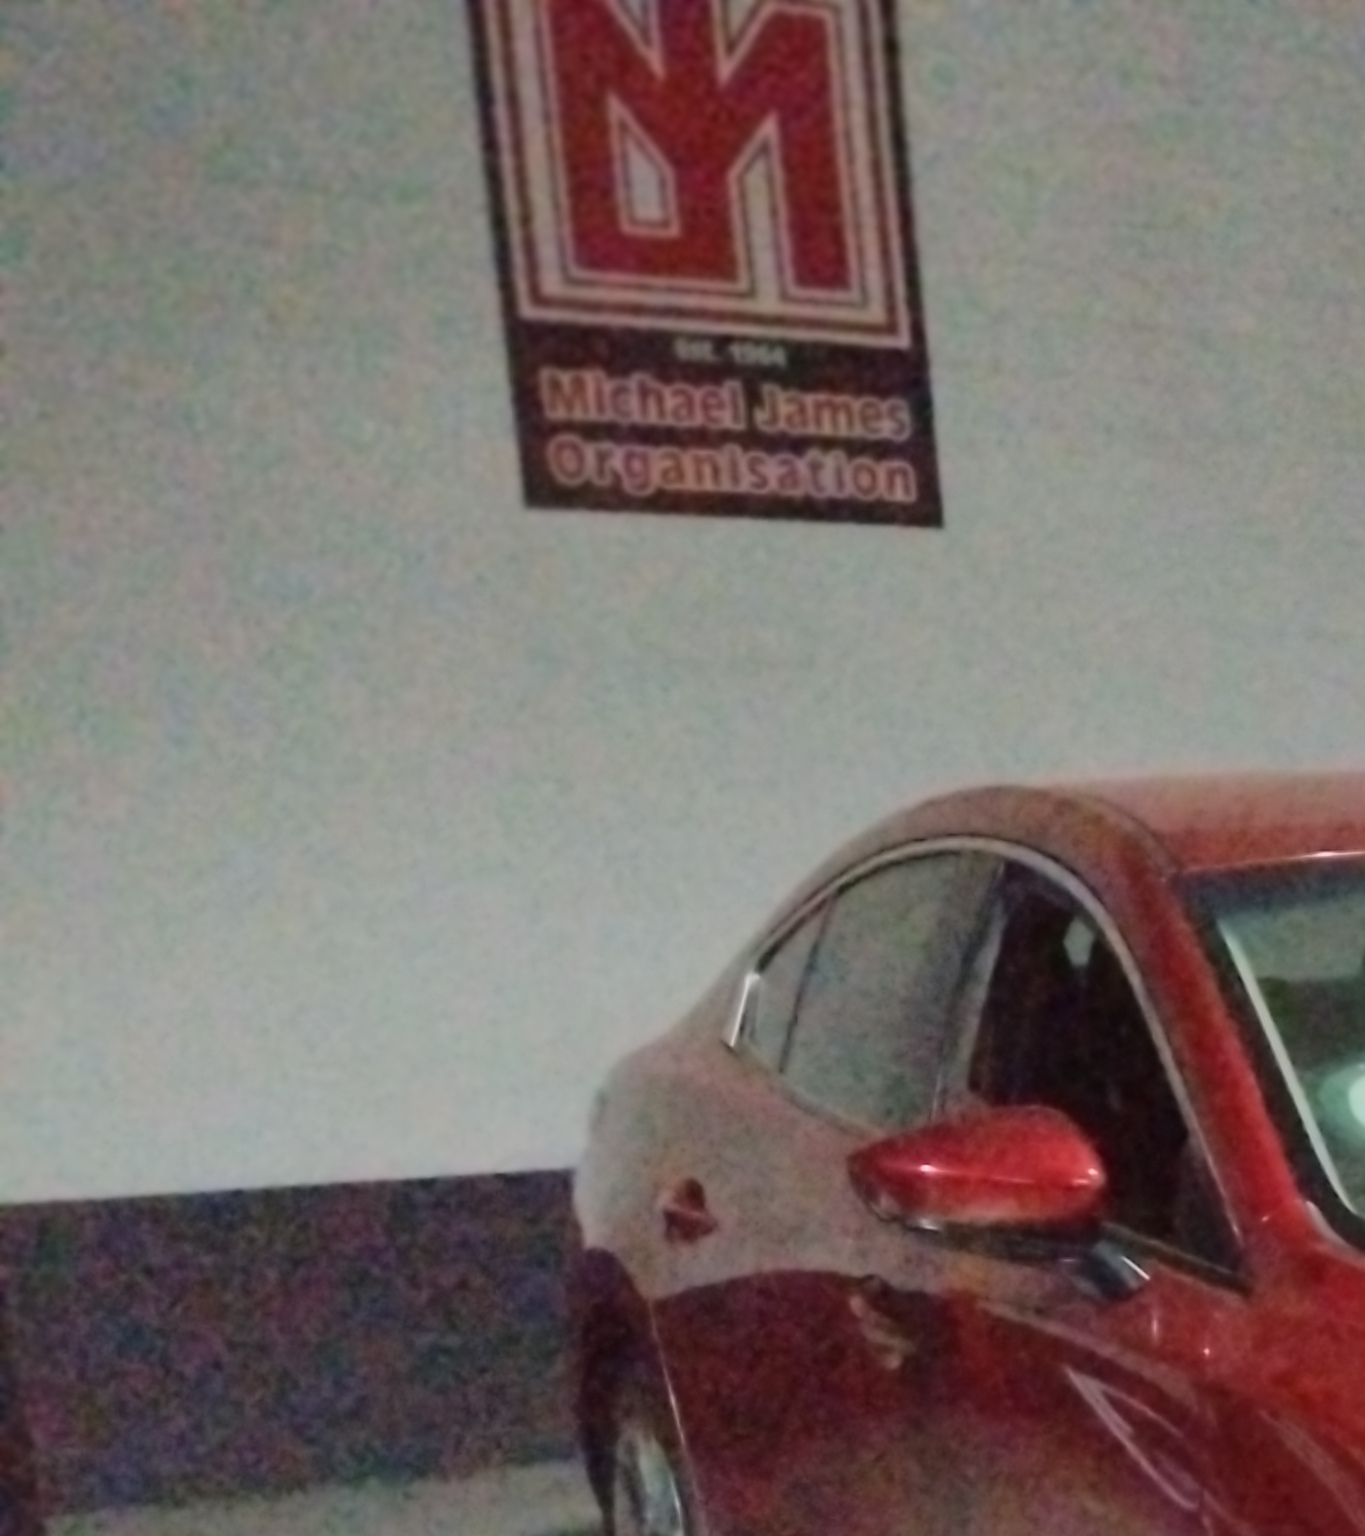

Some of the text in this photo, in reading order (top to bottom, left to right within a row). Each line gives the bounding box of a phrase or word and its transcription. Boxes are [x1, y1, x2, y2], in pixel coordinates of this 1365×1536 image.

[540, 367, 913, 440] Michael James
[547, 434, 918, 502] Organisation
